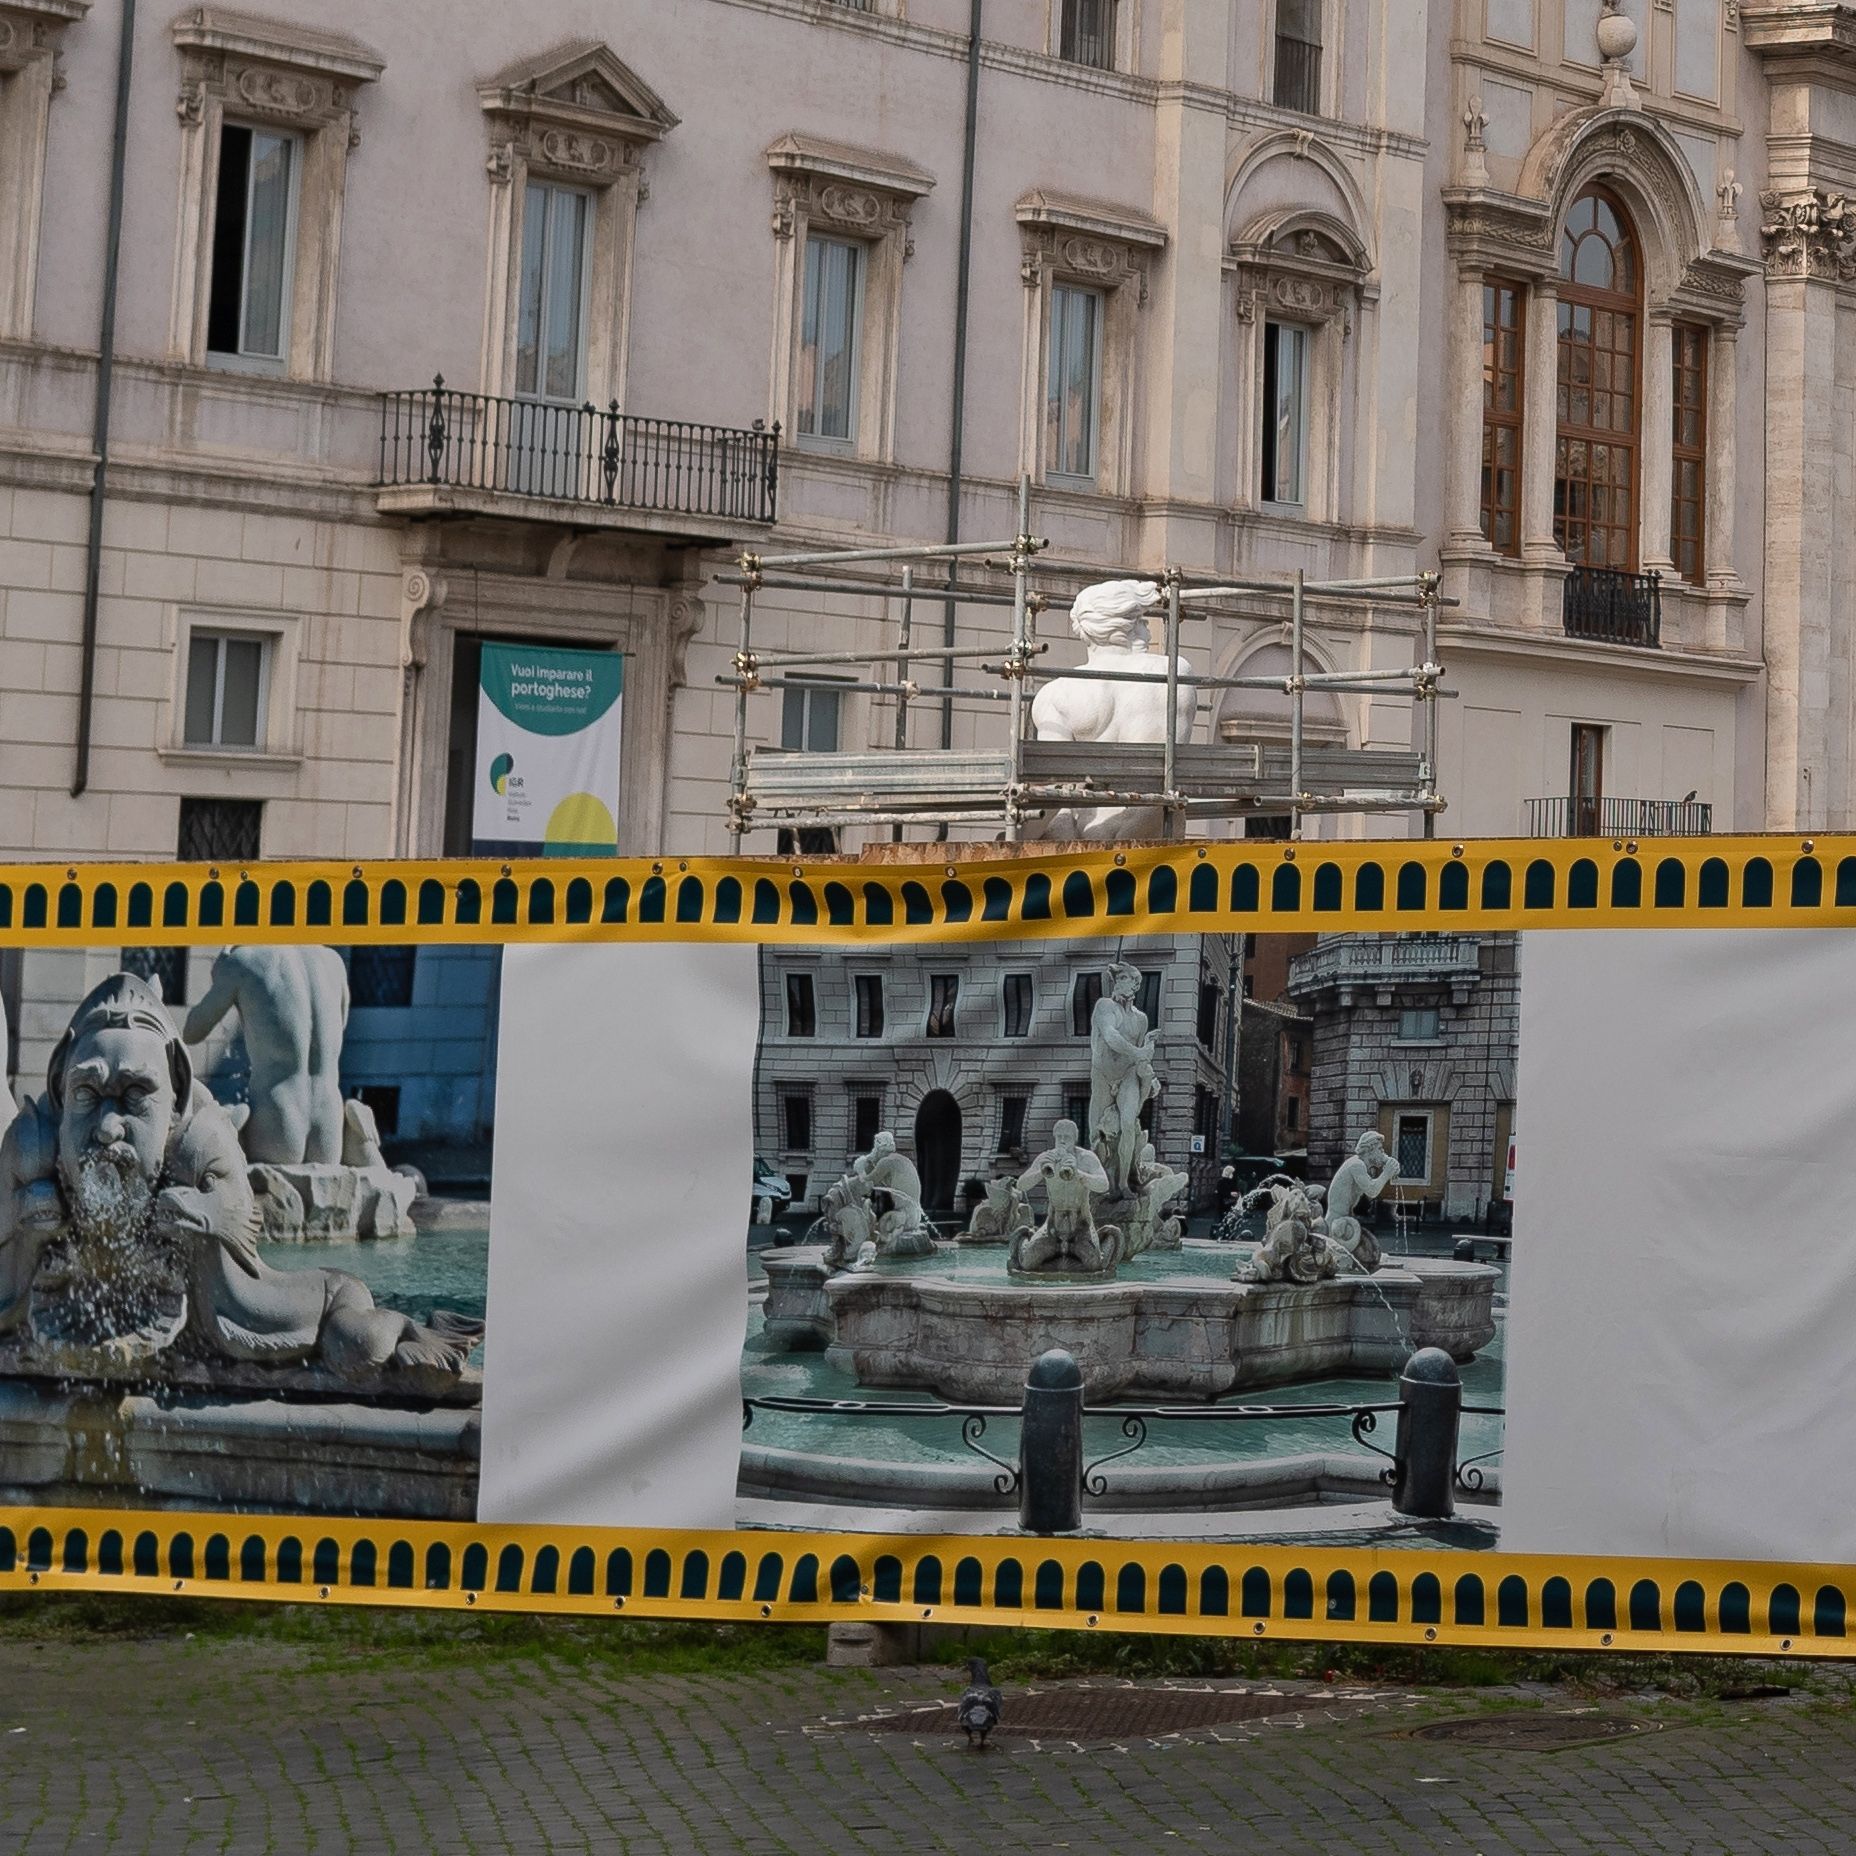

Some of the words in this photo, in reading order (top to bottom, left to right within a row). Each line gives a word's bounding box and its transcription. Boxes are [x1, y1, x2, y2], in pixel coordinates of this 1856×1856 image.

[511, 664, 535, 678] Vuoi
[537, 665, 583, 681] imparare
[585, 669, 593, 682] il
[511, 681, 591, 700] portoghese?
